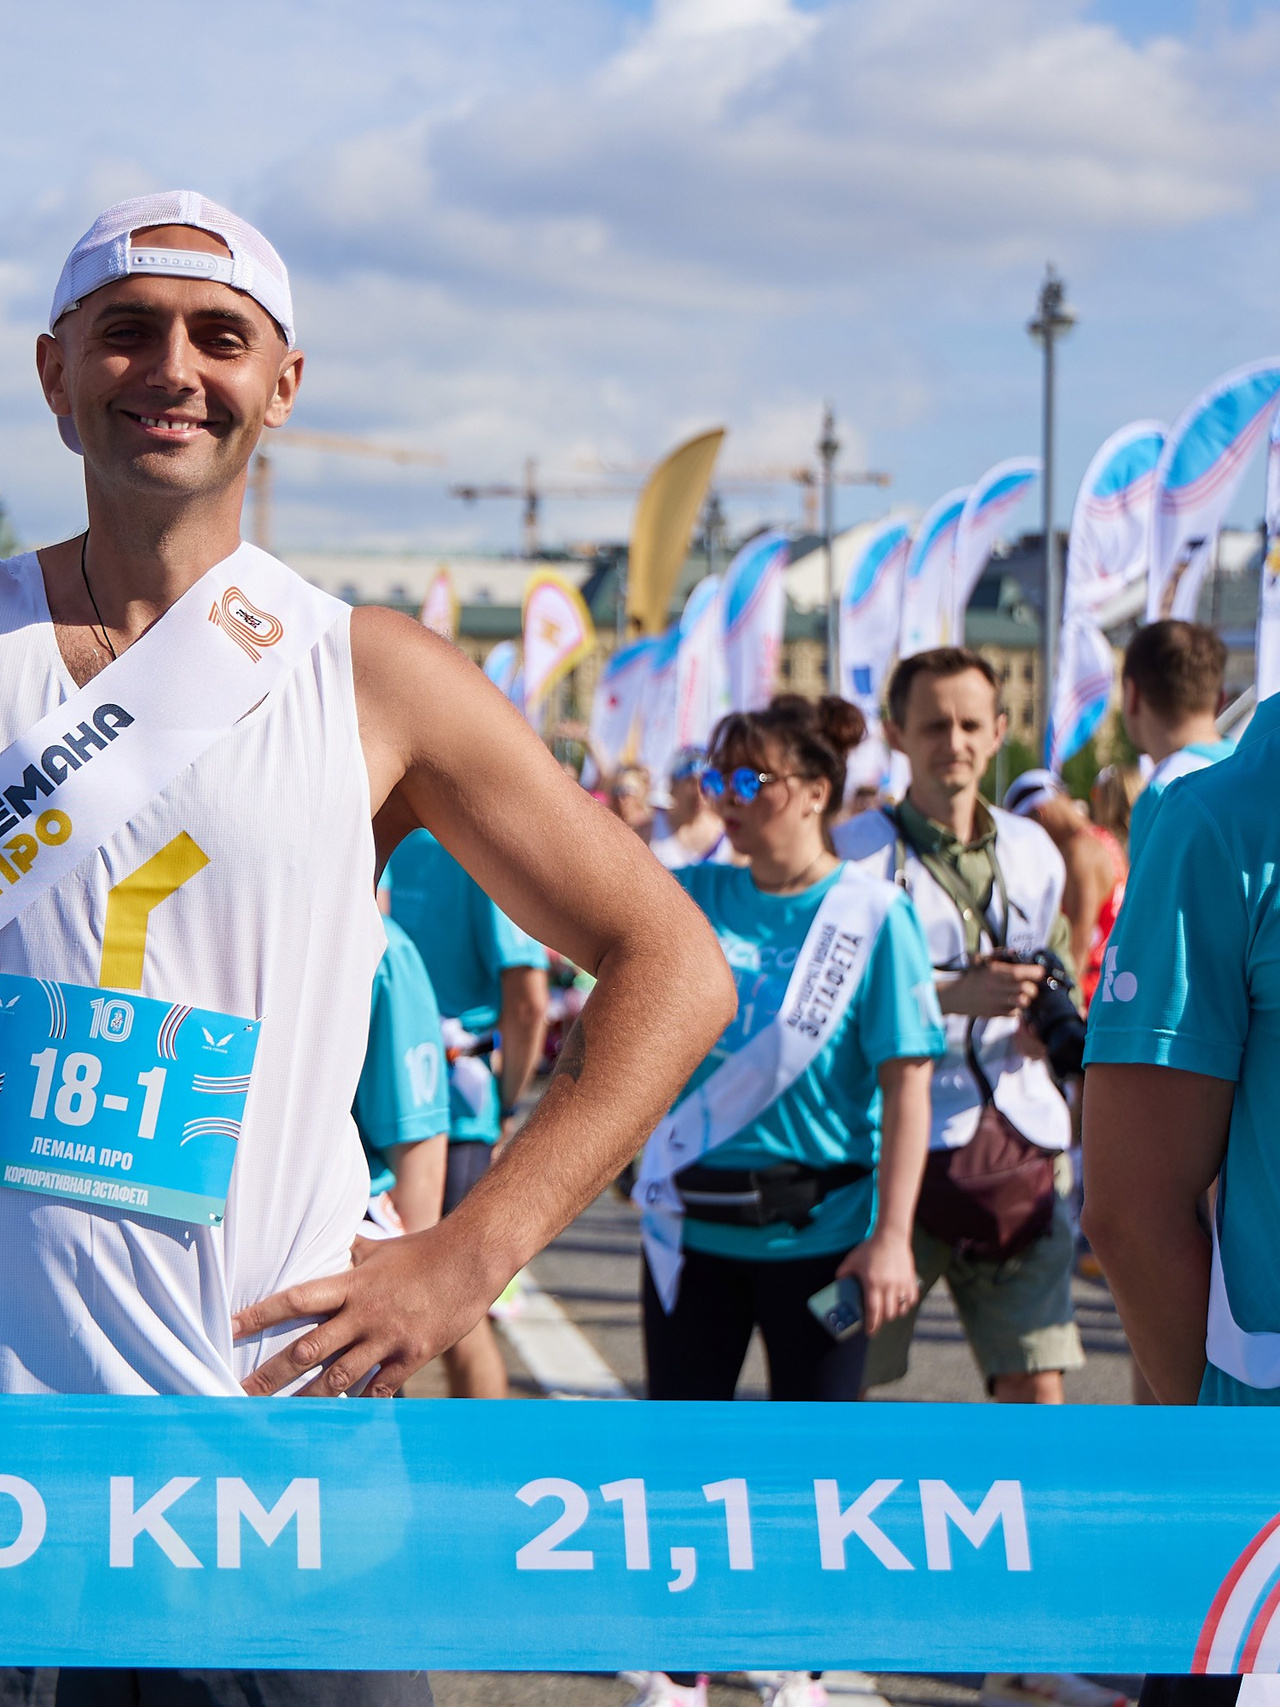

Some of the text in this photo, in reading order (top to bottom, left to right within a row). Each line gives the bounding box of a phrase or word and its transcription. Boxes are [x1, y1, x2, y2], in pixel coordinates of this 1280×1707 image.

[30, 1047, 168, 1140] 18-1
[4, 1165, 149, 1206] КОРПОРАТИВНАЯ ЭСТАФЕТА
[30, 1136, 134, 1171] ЛЕМАНА ПРО
[108, 1475, 321, 1569] КМ
[514, 1477, 754, 1593] 21,1
[813, 1478, 1031, 1573] КМ
